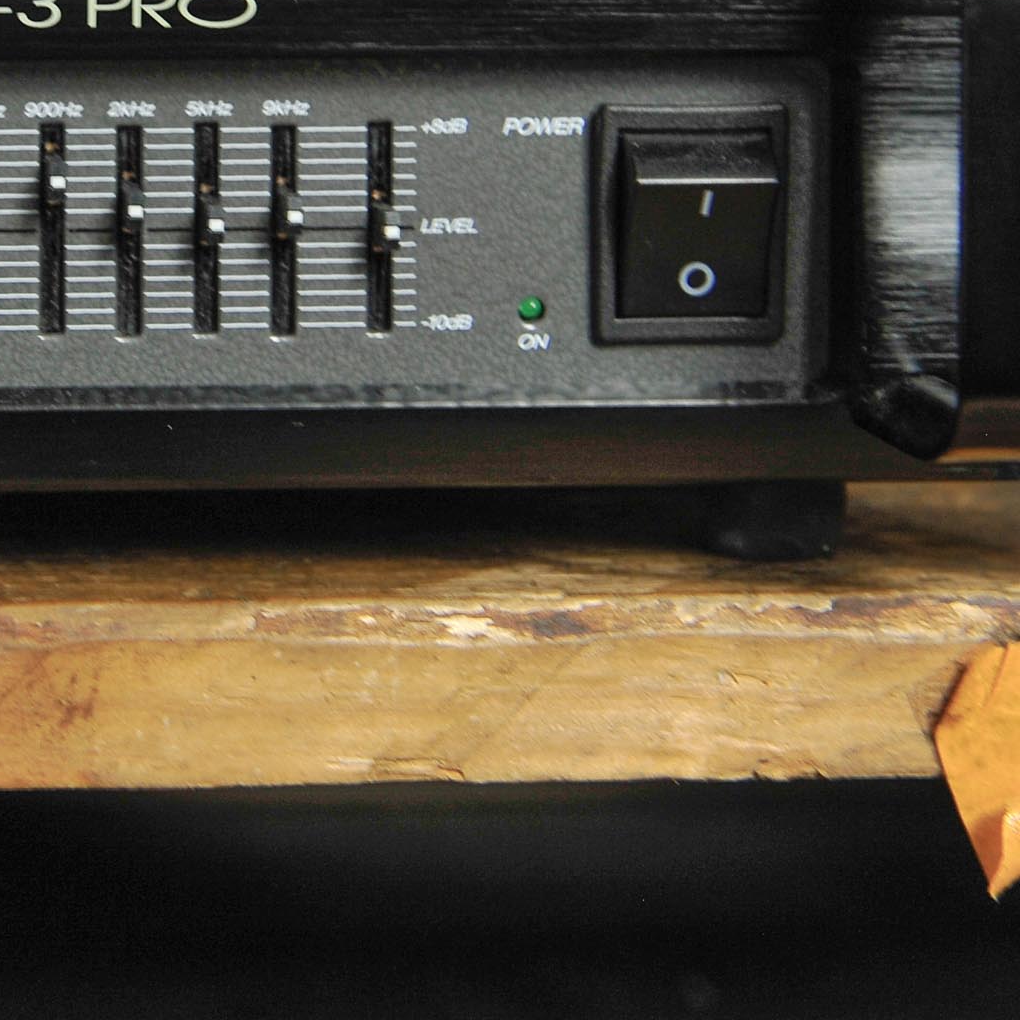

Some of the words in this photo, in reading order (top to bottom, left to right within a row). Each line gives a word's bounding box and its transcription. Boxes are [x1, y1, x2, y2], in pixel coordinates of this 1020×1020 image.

[23, 101, 84, 118] 900Hz
[502, 116, 585, 136] POWER
[420, 217, 478, 234] LEVEL
[420, 313, 473, 331] -10dB
[517, 333, 550, 350] ON
